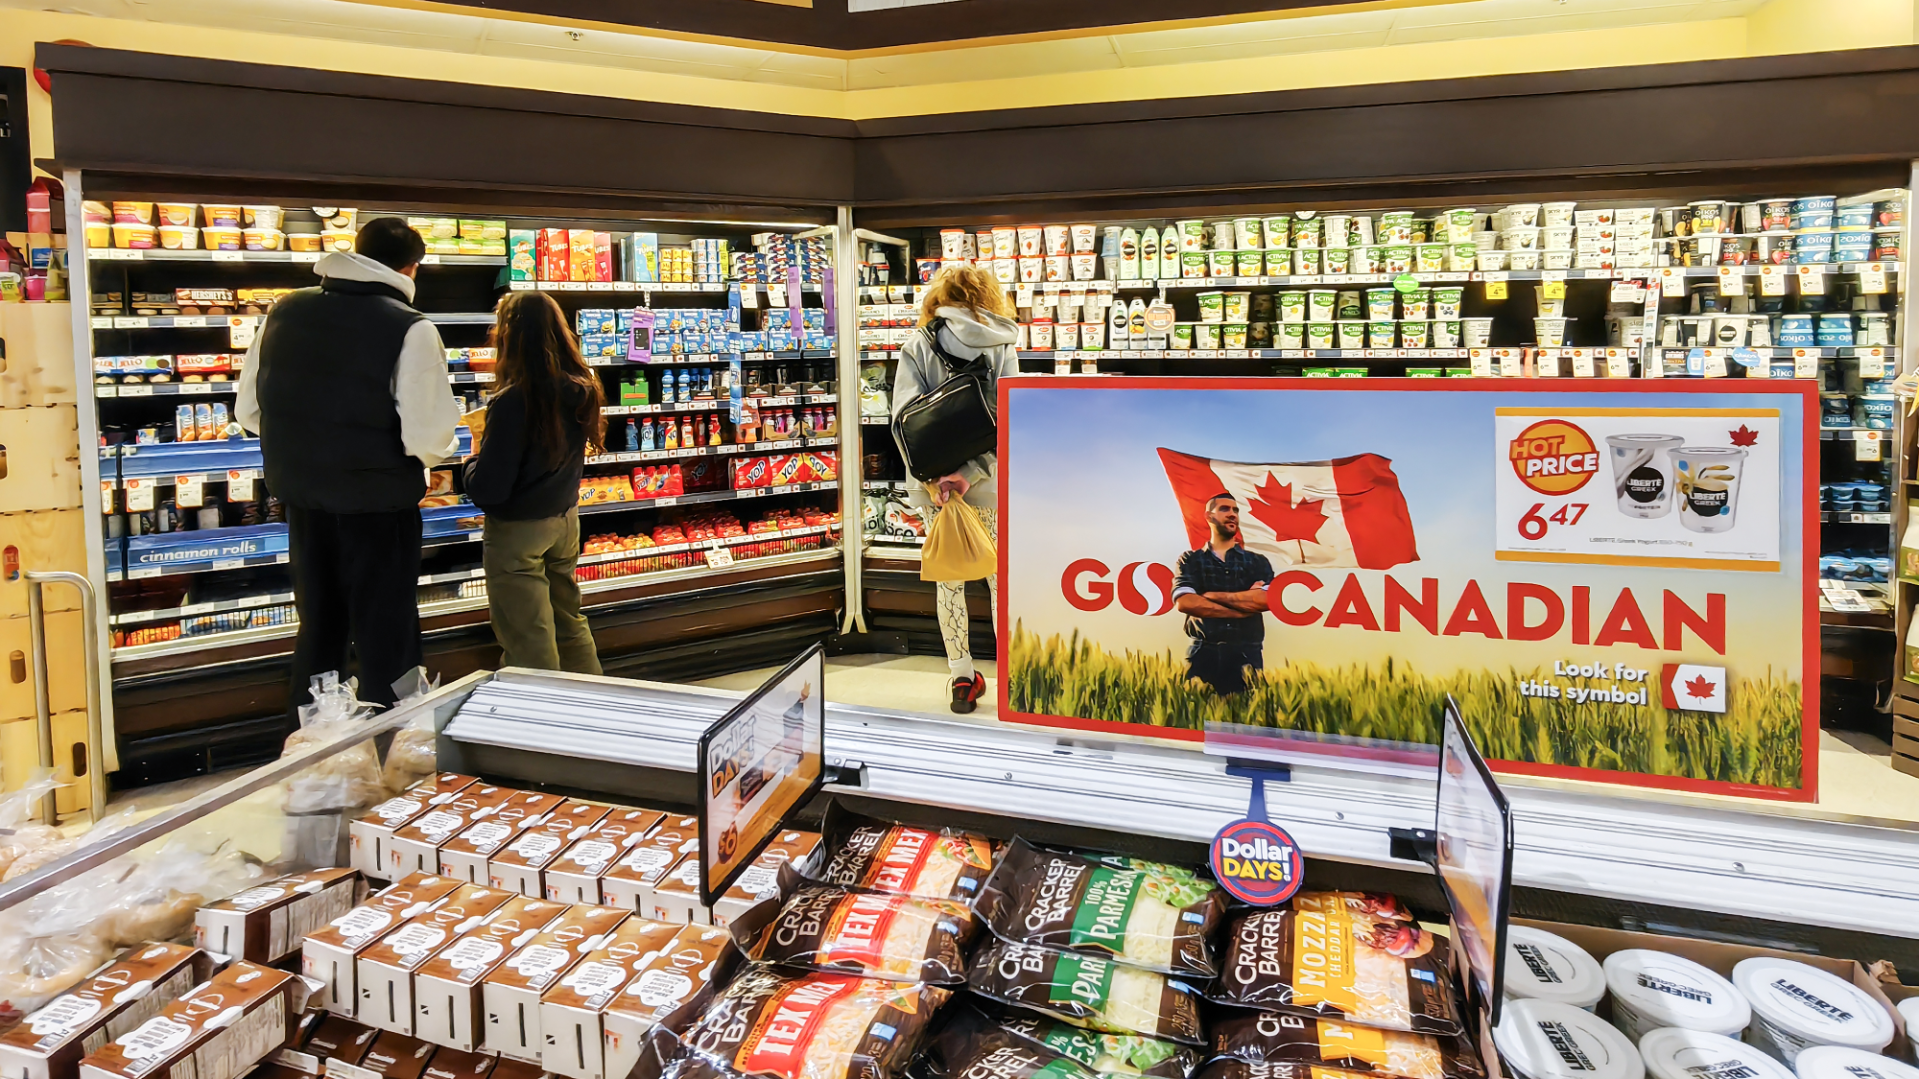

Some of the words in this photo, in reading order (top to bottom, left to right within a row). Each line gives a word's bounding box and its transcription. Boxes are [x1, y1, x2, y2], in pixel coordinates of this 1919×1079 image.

[1511, 437, 1562, 460] HOT
[747, 460, 767, 485] YOP
[778, 457, 799, 481] YOP
[1526, 452, 1599, 478] PRICE
[139, 544, 218, 564] cinnamon
[222, 541, 257, 557] rolls
[1267, 569, 1726, 656] CANADIAN
[1554, 659, 1607, 680] Look
[1614, 662, 1650, 684] for
[1519, 678, 1562, 699] this
[1564, 682, 1648, 707] symbol
[711, 714, 756, 775] Dollar
[838, 828, 886, 887] BARREL
[885, 826, 933, 868] MEX
[1220, 836, 1293, 864] Dollar
[1222, 857, 1292, 883] DAYS!
[1024, 857, 1063, 932] CRACKER
[1046, 864, 1087, 923] BARREL
[1084, 879, 1108, 907] 100%
[1089, 871, 1139, 941] PARMESAN
[834, 914, 881, 948] TEX
[783, 981, 848, 1006] MEX
[752, 1005, 815, 1057] TEX
